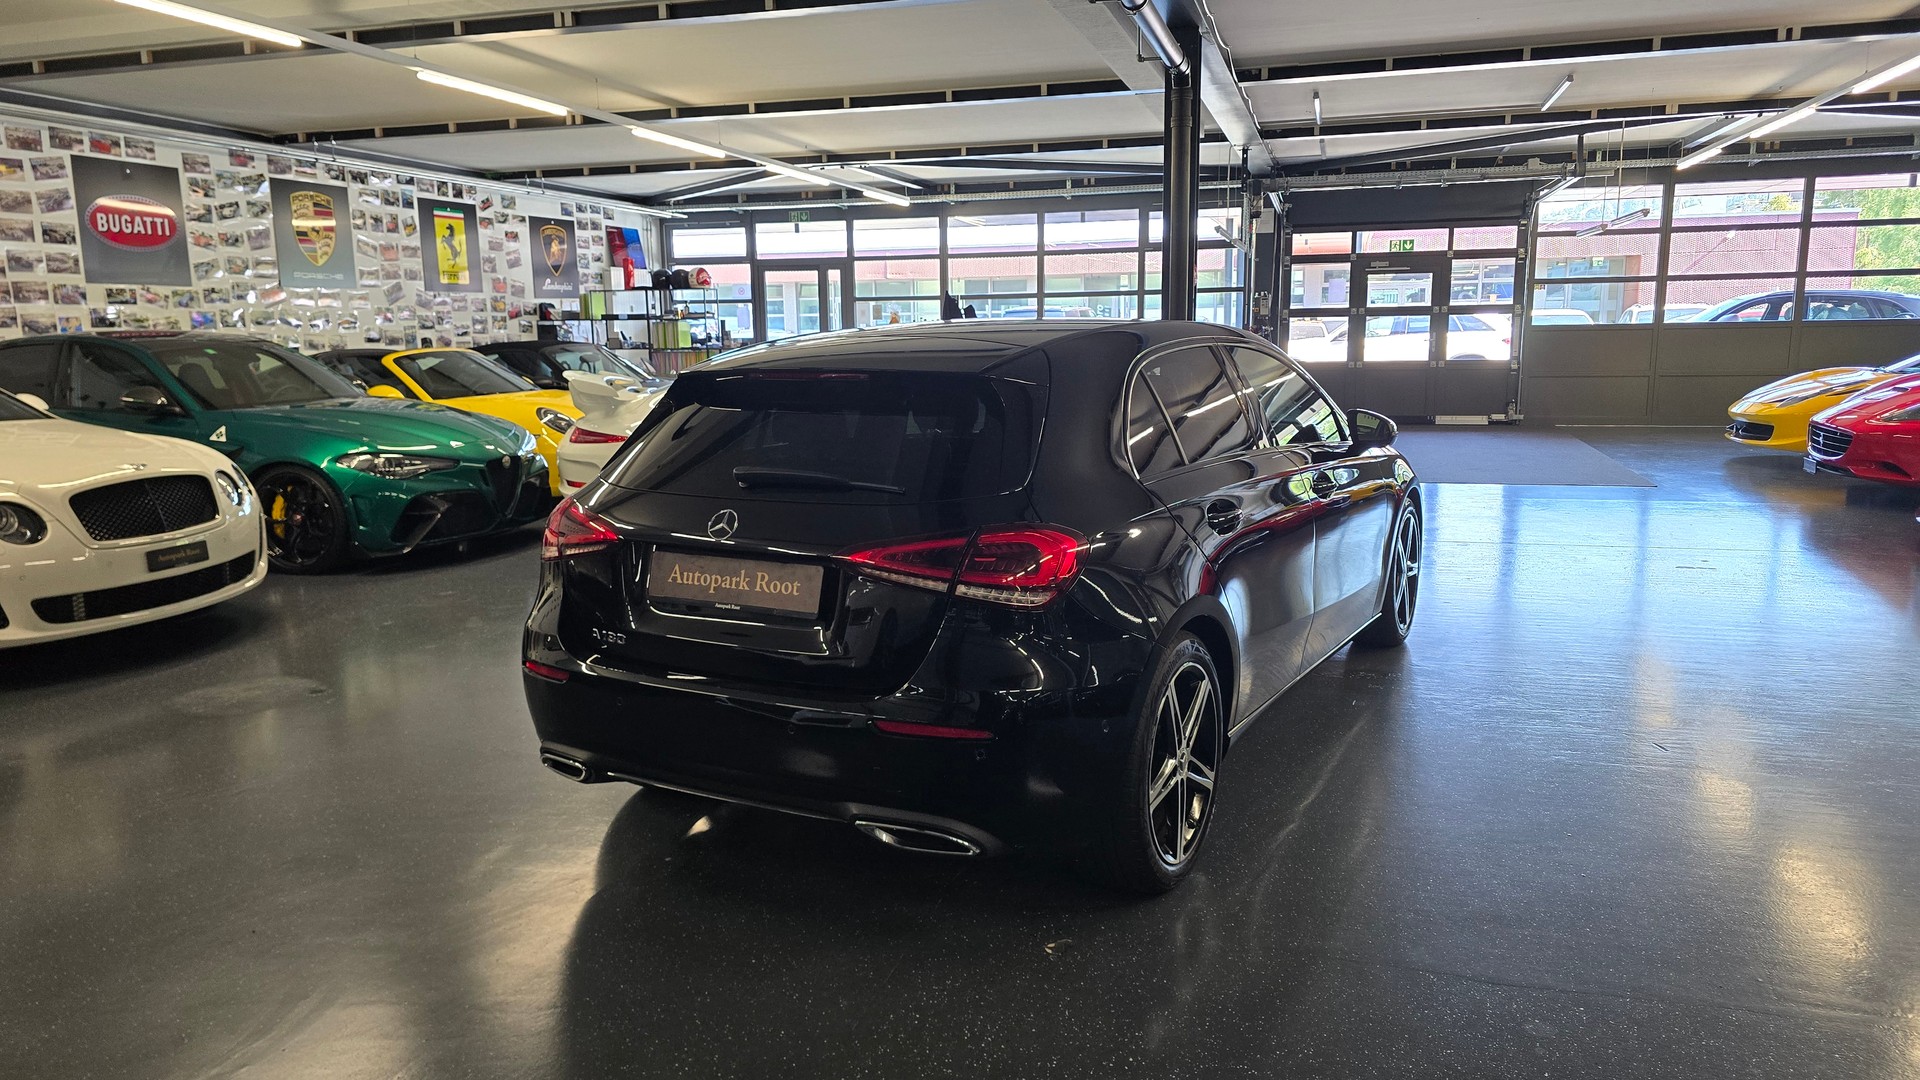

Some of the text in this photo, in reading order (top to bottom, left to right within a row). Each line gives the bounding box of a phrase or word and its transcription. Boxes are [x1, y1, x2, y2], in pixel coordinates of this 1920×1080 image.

[96, 212, 171, 237] BUGATTI
[293, 271, 344, 280] PORSCHE
[667, 563, 802, 596] Autopark Root
[714, 602, 731, 610] Autopark
